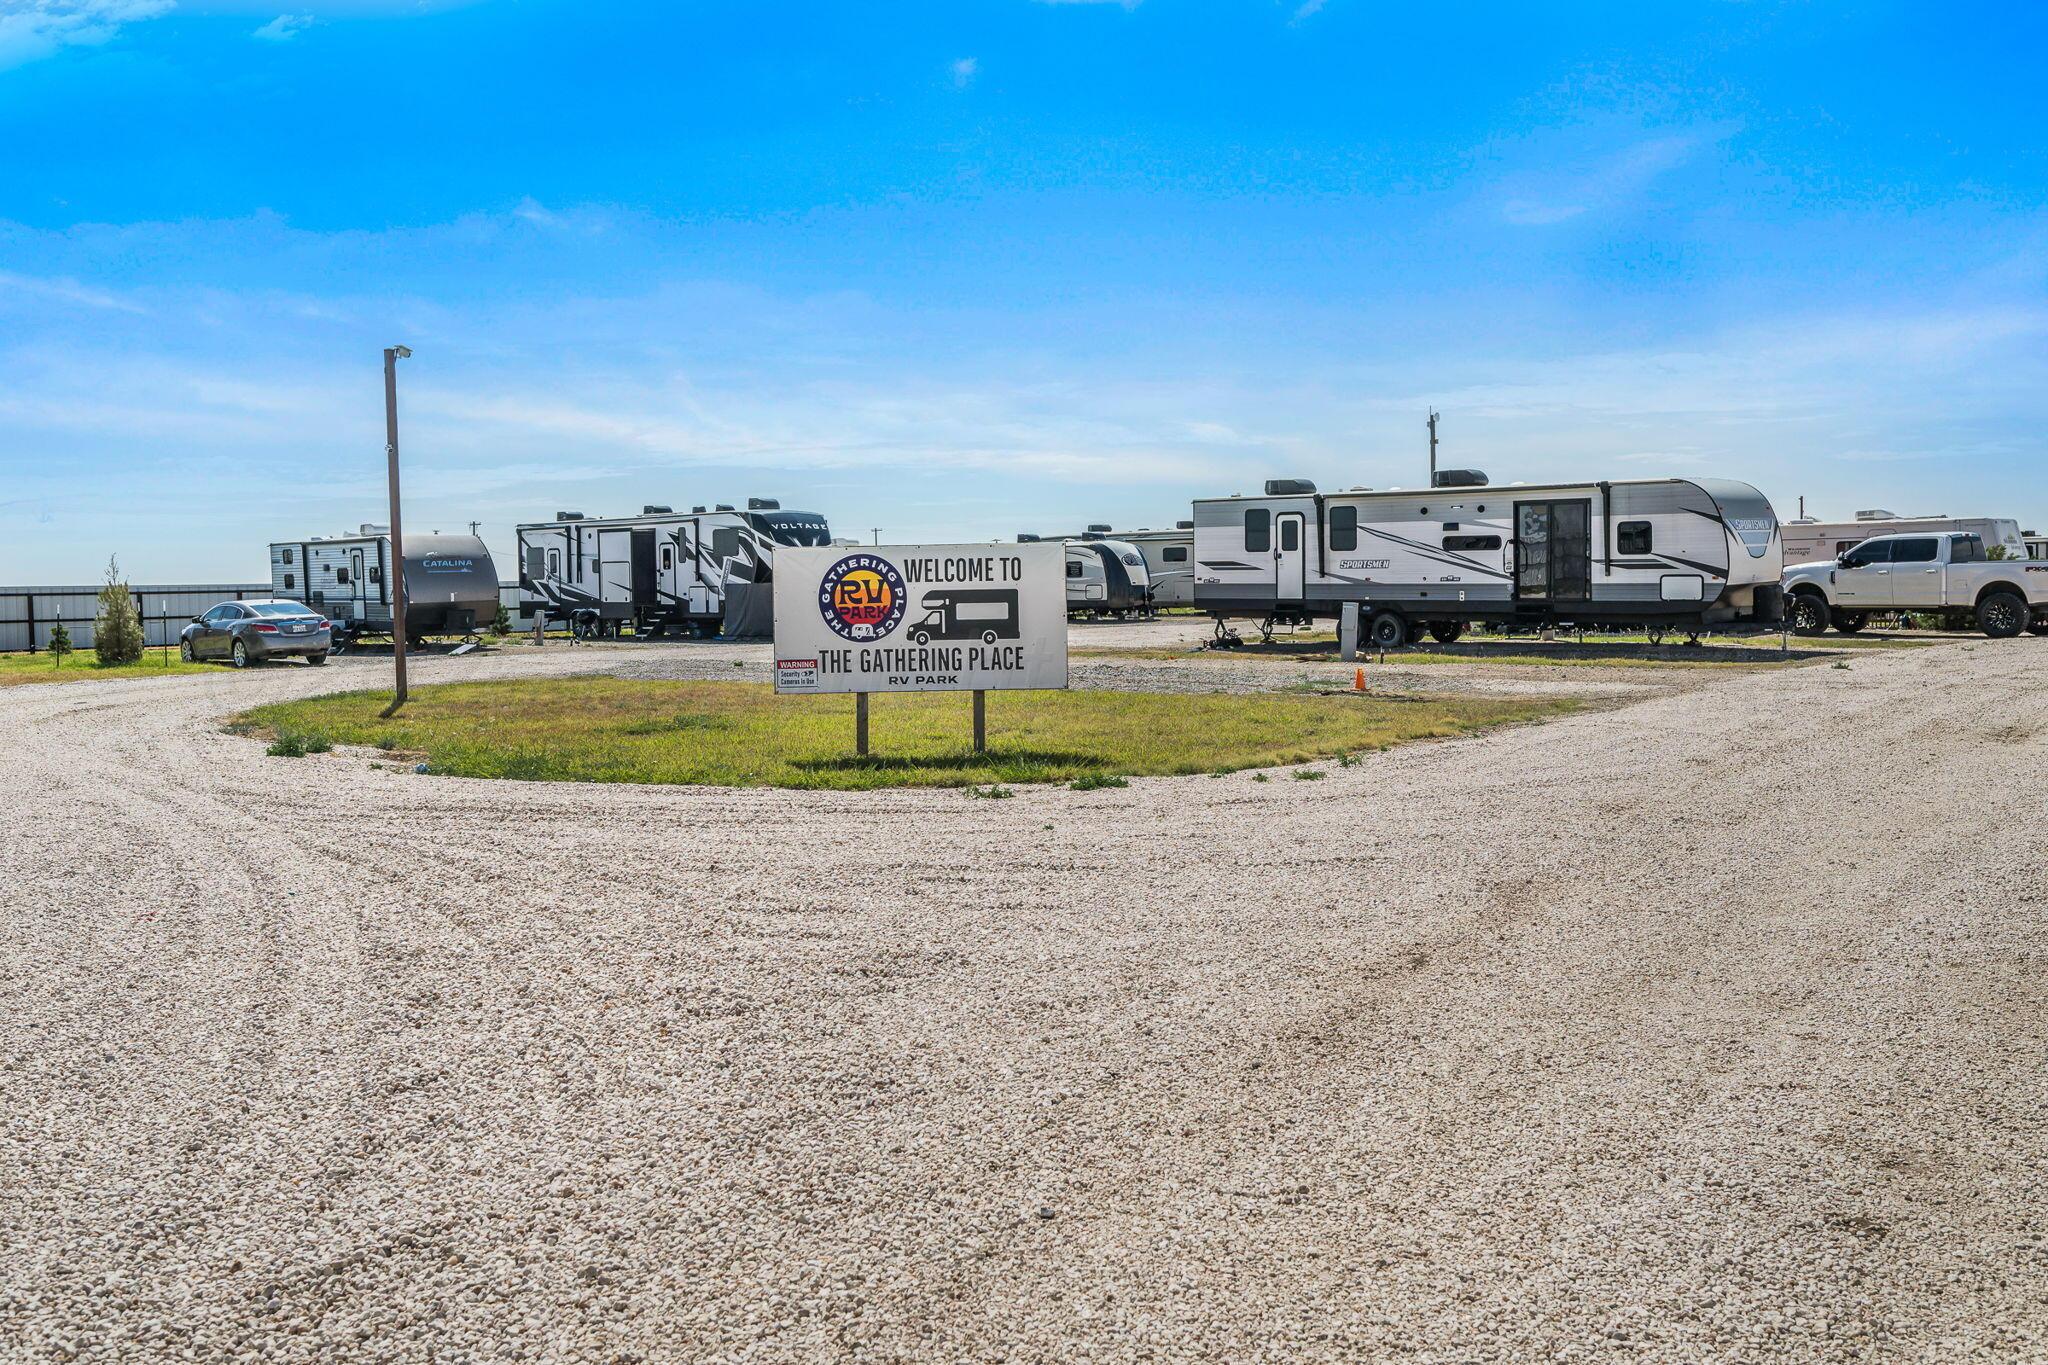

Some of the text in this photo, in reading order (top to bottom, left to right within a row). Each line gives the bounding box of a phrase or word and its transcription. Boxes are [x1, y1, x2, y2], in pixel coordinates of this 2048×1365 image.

[904, 557, 1022, 583] WELCOME TO
[1340, 560, 1390, 569] SPORTSMEN
[822, 558, 904, 637] THE GATHERING PLACE
[838, 579, 885, 604] RV
[838, 605, 888, 619] PARK
[819, 646, 1025, 673] THE GATHERING PLACE
[888, 675, 959, 685] RV PARK
